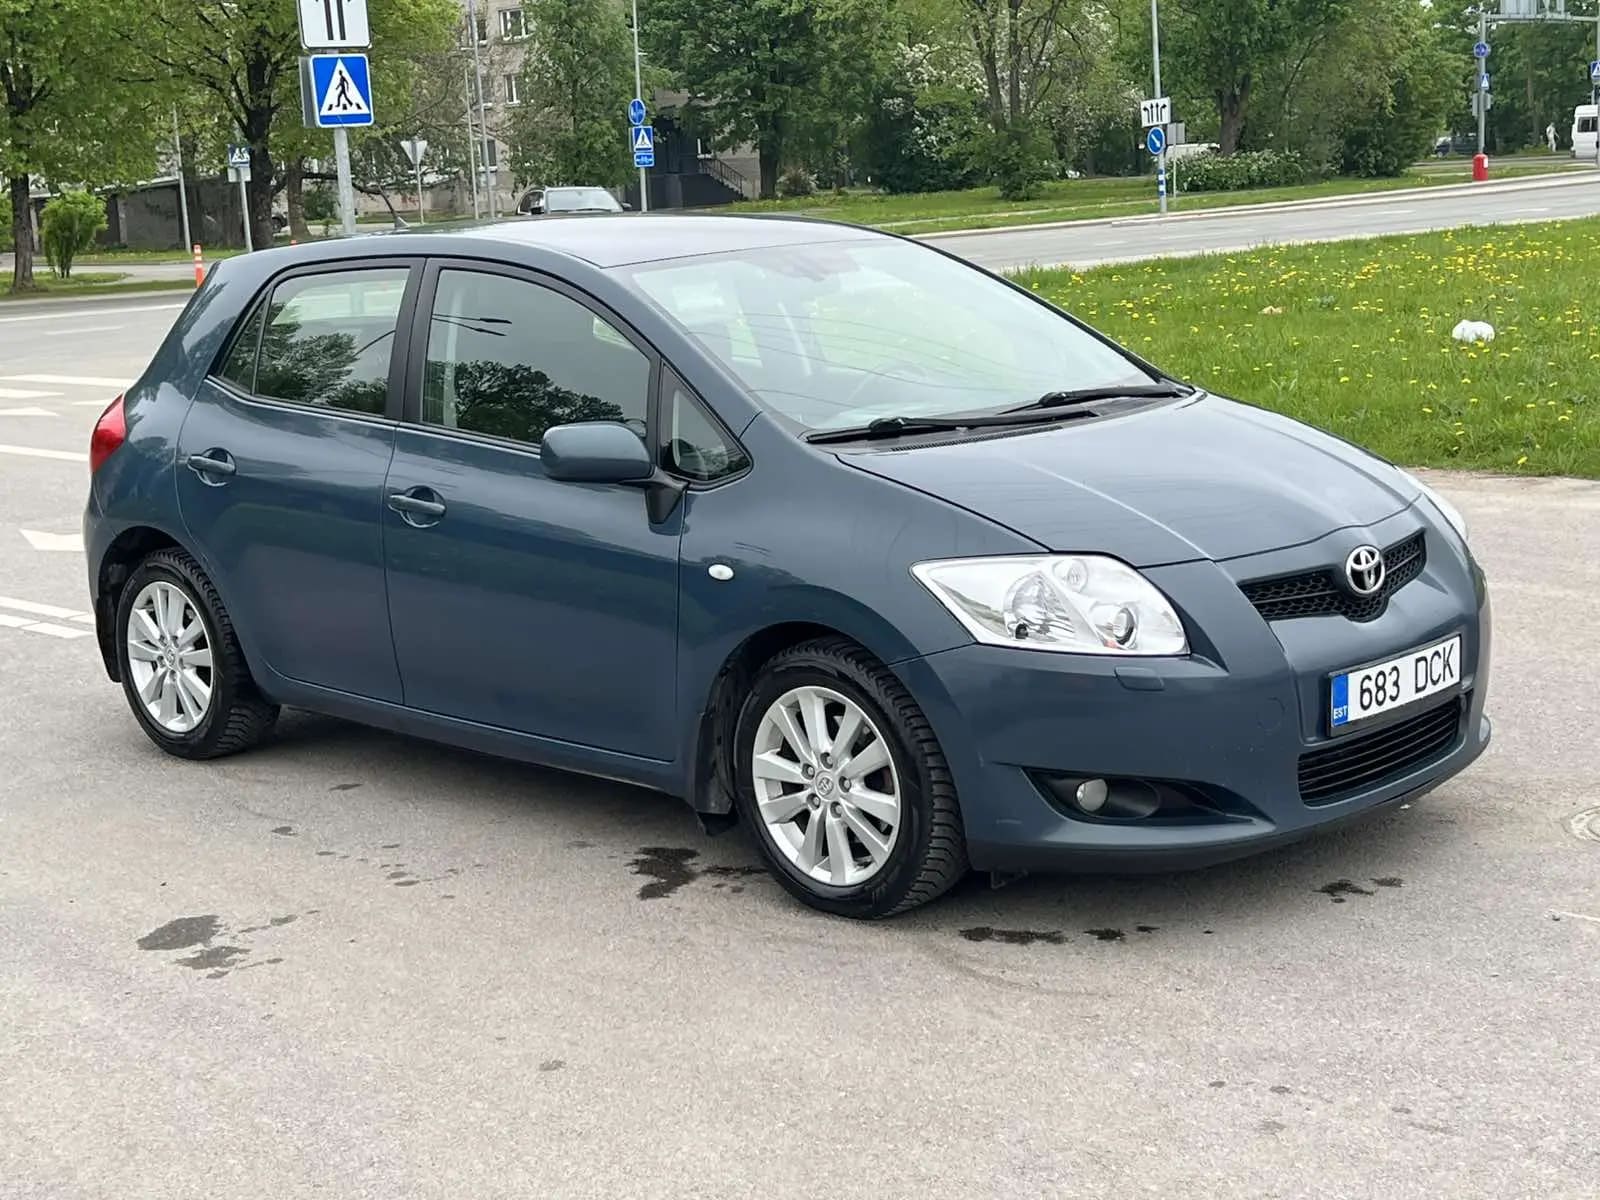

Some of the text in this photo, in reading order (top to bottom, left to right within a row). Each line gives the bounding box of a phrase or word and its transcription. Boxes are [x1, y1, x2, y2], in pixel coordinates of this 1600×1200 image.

[1360, 643, 1454, 711] 683 DCK
[1334, 705, 1348, 720] EST
